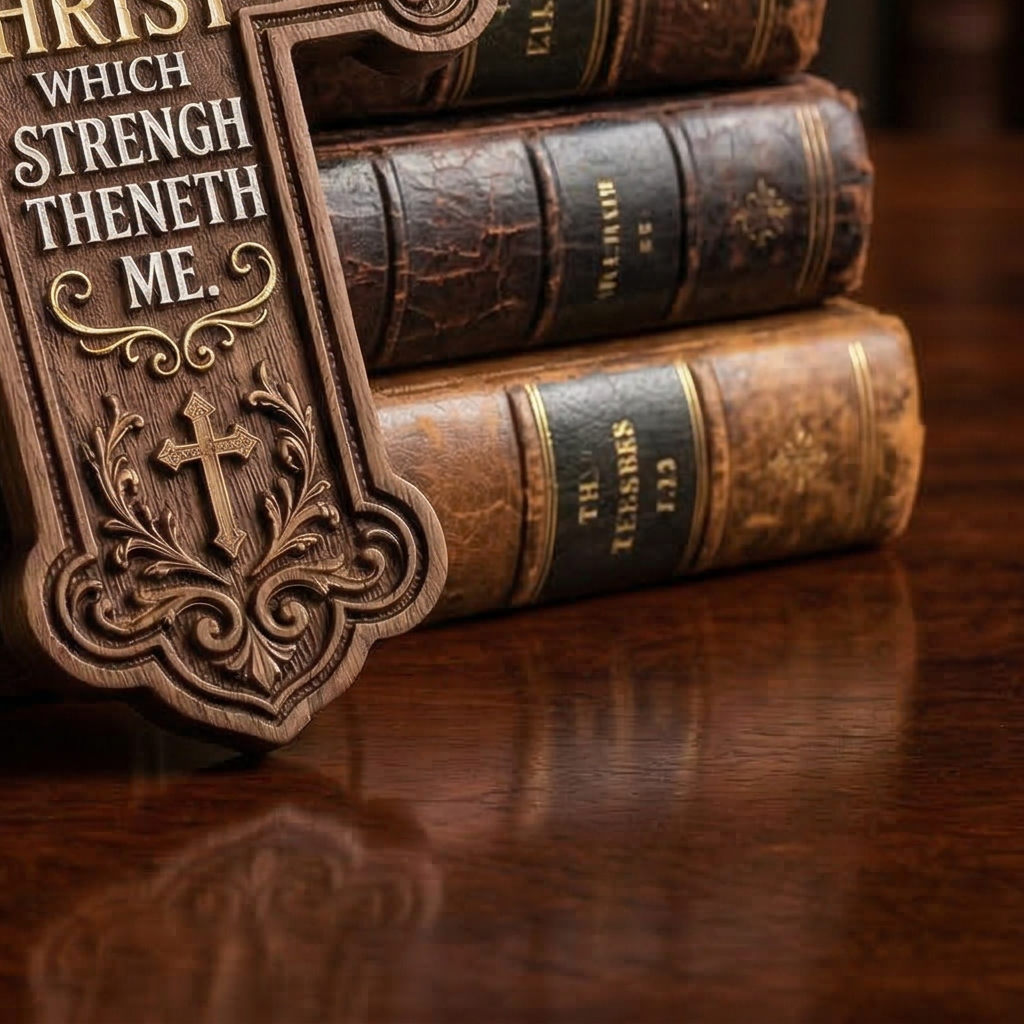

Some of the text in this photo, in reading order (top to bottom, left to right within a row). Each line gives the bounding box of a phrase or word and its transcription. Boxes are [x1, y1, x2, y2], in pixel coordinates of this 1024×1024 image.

[34, 51, 192, 109] WHICH
[12, 96, 252, 188] STRENGH
[24, 164, 269, 250] THENETH
[119, 245, 221, 310] ME.
